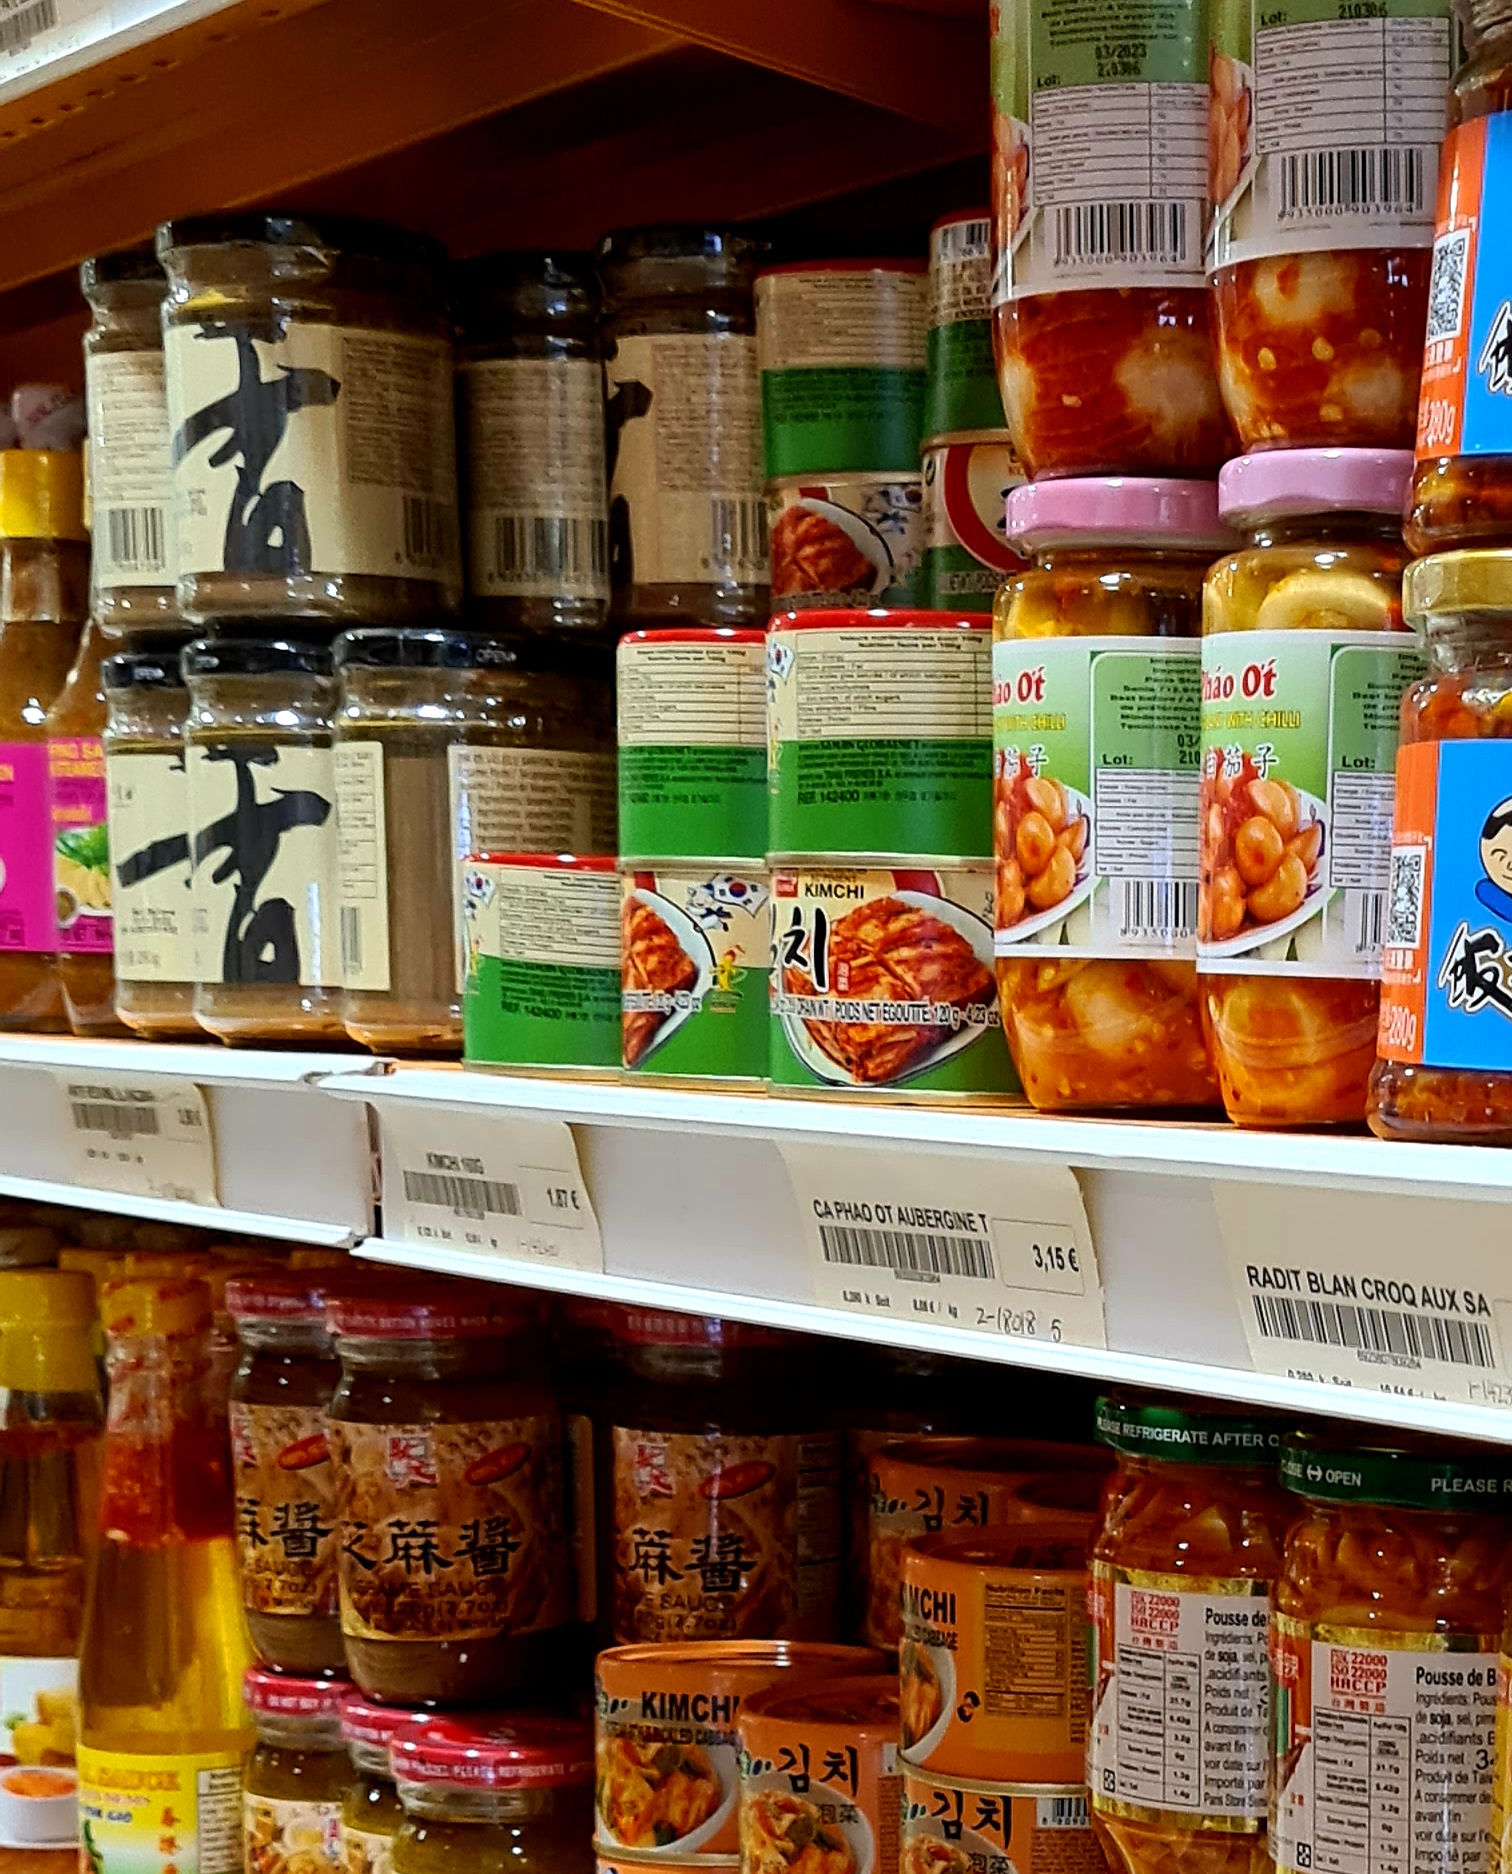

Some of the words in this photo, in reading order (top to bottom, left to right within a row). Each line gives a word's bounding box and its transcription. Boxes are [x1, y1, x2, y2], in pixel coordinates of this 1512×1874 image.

[1102, 754, 1133, 766] Lot:
[1341, 755, 1376, 769] Lot:
[804, 883, 864, 899] KIMCHI
[813, 1199, 833, 1219] CA
[834, 1201, 871, 1223] PHAO
[874, 1204, 893, 1224] OT
[898, 1207, 976, 1232] AUBERGINE
[1032, 1244, 1065, 1273] 3,15
[1246, 1265, 1301, 1292] RADIT
[1306, 1271, 1357, 1300] BLAN
[1361, 1277, 1416, 1308] CROQ
[1421, 1285, 1457, 1313] AUX
[1462, 1290, 1492, 1317] SA
[1122, 1422, 1209, 1446] REFRIGERATE
[1212, 1430, 1265, 1448] AFTER
[1325, 1469, 1362, 1487] OPEN
[1431, 1477, 1497, 1495] PLEASE
[1205, 1608, 1248, 1626] Pousse
[1252, 1610, 1266, 1626] de
[1415, 1666, 1463, 1685] Pousse
[1467, 1669, 1483, 1686] de
[778, 1743, 859, 1797] 김치
[934, 1789, 1013, 1850] 김치
